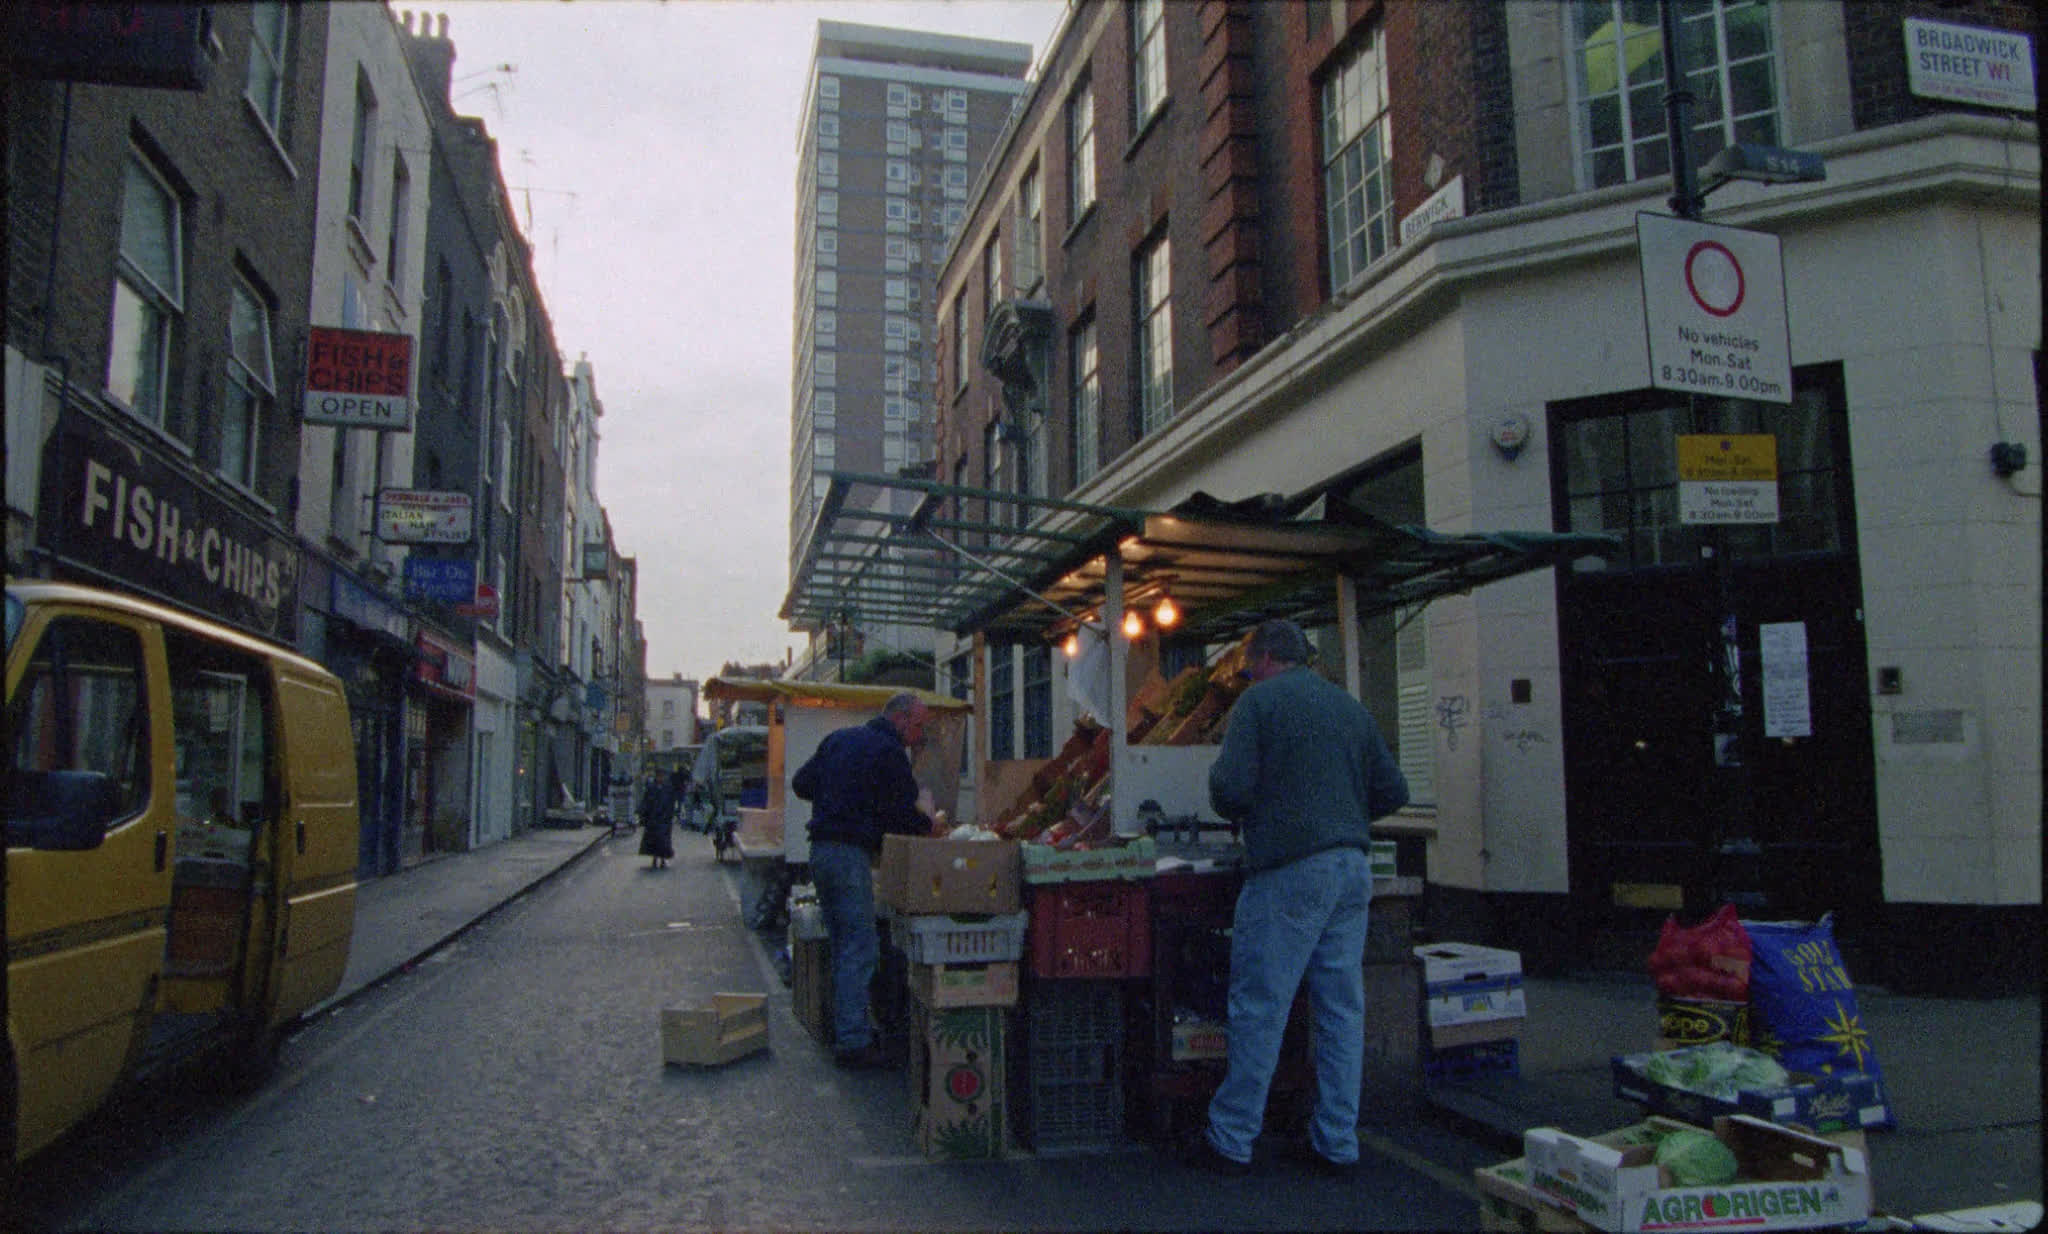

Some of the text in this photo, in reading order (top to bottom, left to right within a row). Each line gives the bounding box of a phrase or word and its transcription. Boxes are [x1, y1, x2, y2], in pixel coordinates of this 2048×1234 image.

[1917, 27, 2020, 62] BROADWICK
[1919, 51, 2011, 81] STREET W1
[1678, 326, 1760, 351] No vehicles
[313, 343, 383, 368] FISH
[310, 368, 408, 397] CHIPS
[321, 397, 392, 418] OPEN
[382, 510, 424, 520] ITALIAN
[82, 458, 181, 564] FISH
[202, 527, 281, 610] CHIPS
[1641, 1186, 1823, 1225] AGRORIGEN
